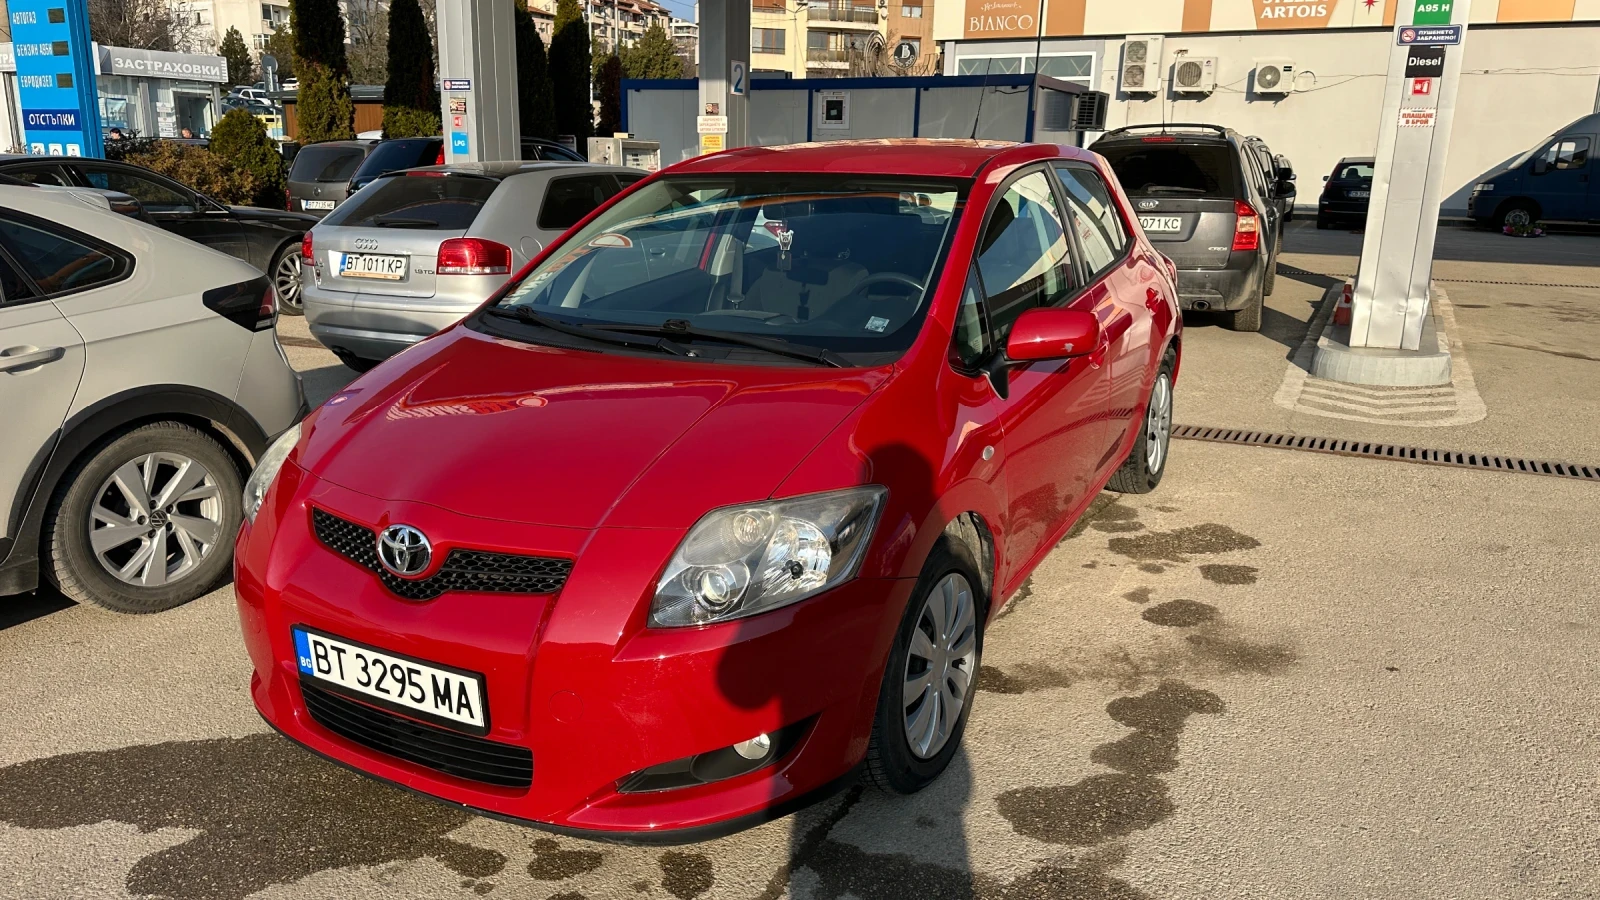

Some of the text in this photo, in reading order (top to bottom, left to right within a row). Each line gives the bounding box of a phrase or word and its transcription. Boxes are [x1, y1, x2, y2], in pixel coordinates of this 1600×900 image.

[1260, 4, 1327, 19] ARTOIS
[1417, 4, 1450, 12] A95 H
[12, 11, 37, 24] АВТОГАЗ
[114, 57, 220, 76] ЗАСТРАХОВКИ
[1408, 57, 1442, 66] Diesel
[733, 63, 744, 93] 2
[28, 114, 75, 126] ОТСТЪПКИ
[1164, 218, 1179, 229] KC
[346, 256, 403, 273] BT 1011 KP
[300, 656, 312, 669] BG
[312, 639, 475, 719] BT 3295 MA
